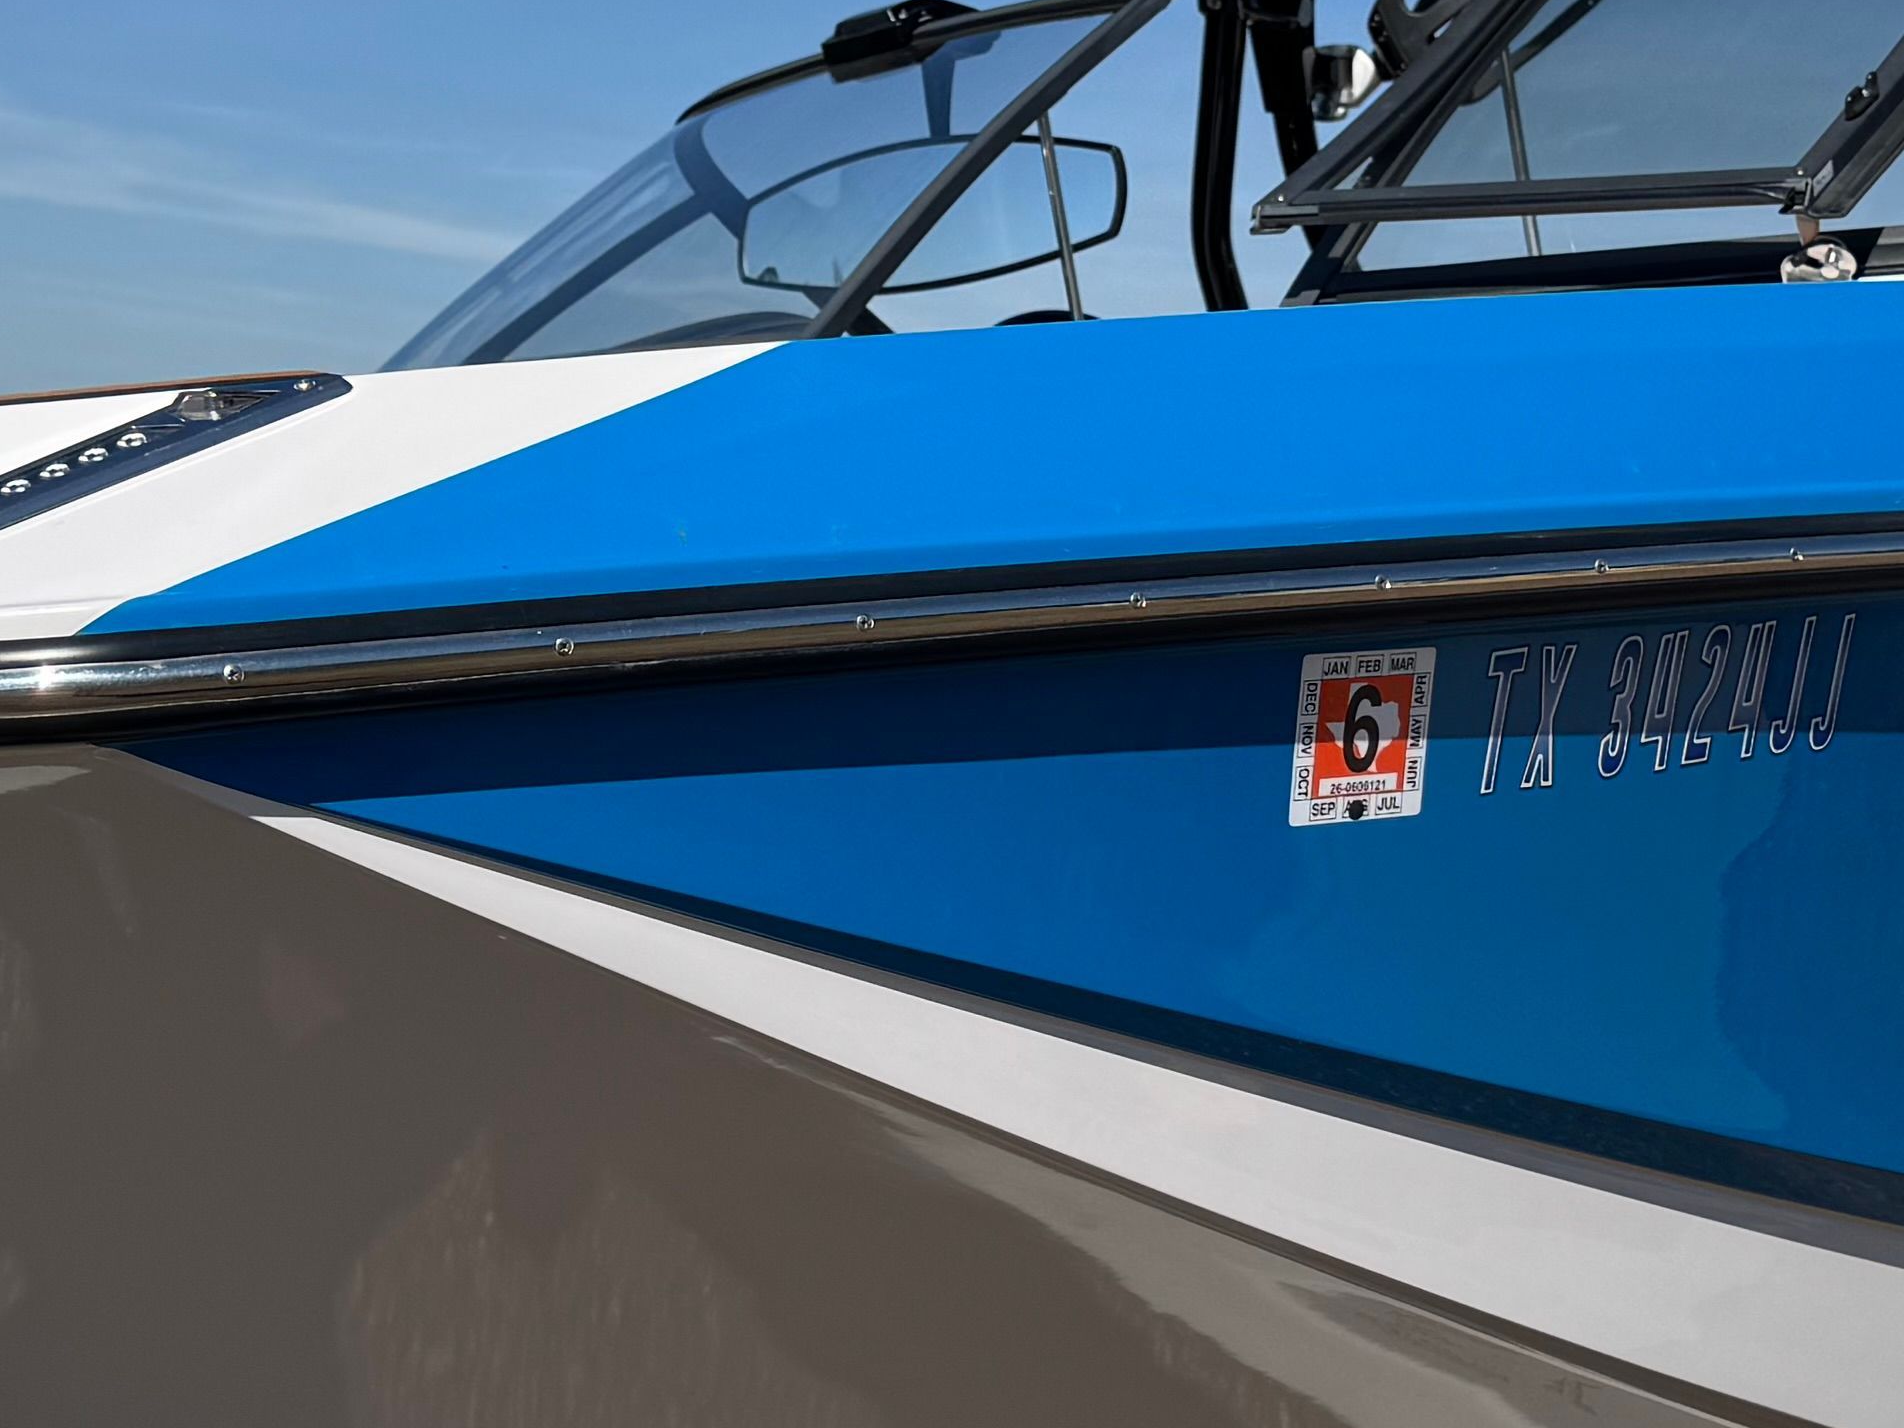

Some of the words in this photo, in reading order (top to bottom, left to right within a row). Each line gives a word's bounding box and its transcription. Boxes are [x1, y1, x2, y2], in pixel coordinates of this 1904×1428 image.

[1323, 659, 1349, 676] JAN
[1358, 658, 1382, 674] FEB
[1391, 657, 1414, 672] MAR
[1305, 682, 1318, 713] DEC
[1415, 675, 1427, 705] APR
[1480, 644, 1578, 794] TX
[1598, 613, 1856, 777] 3424JJ
[1302, 724, 1315, 755] NOV
[1343, 684, 1382, 773] 6
[1410, 719, 1422, 747] MAY
[1298, 767, 1310, 797] OCT
[1406, 759, 1418, 788] JUN
[1311, 801, 1336, 817] SEP
[1377, 795, 1400, 811] JUL
